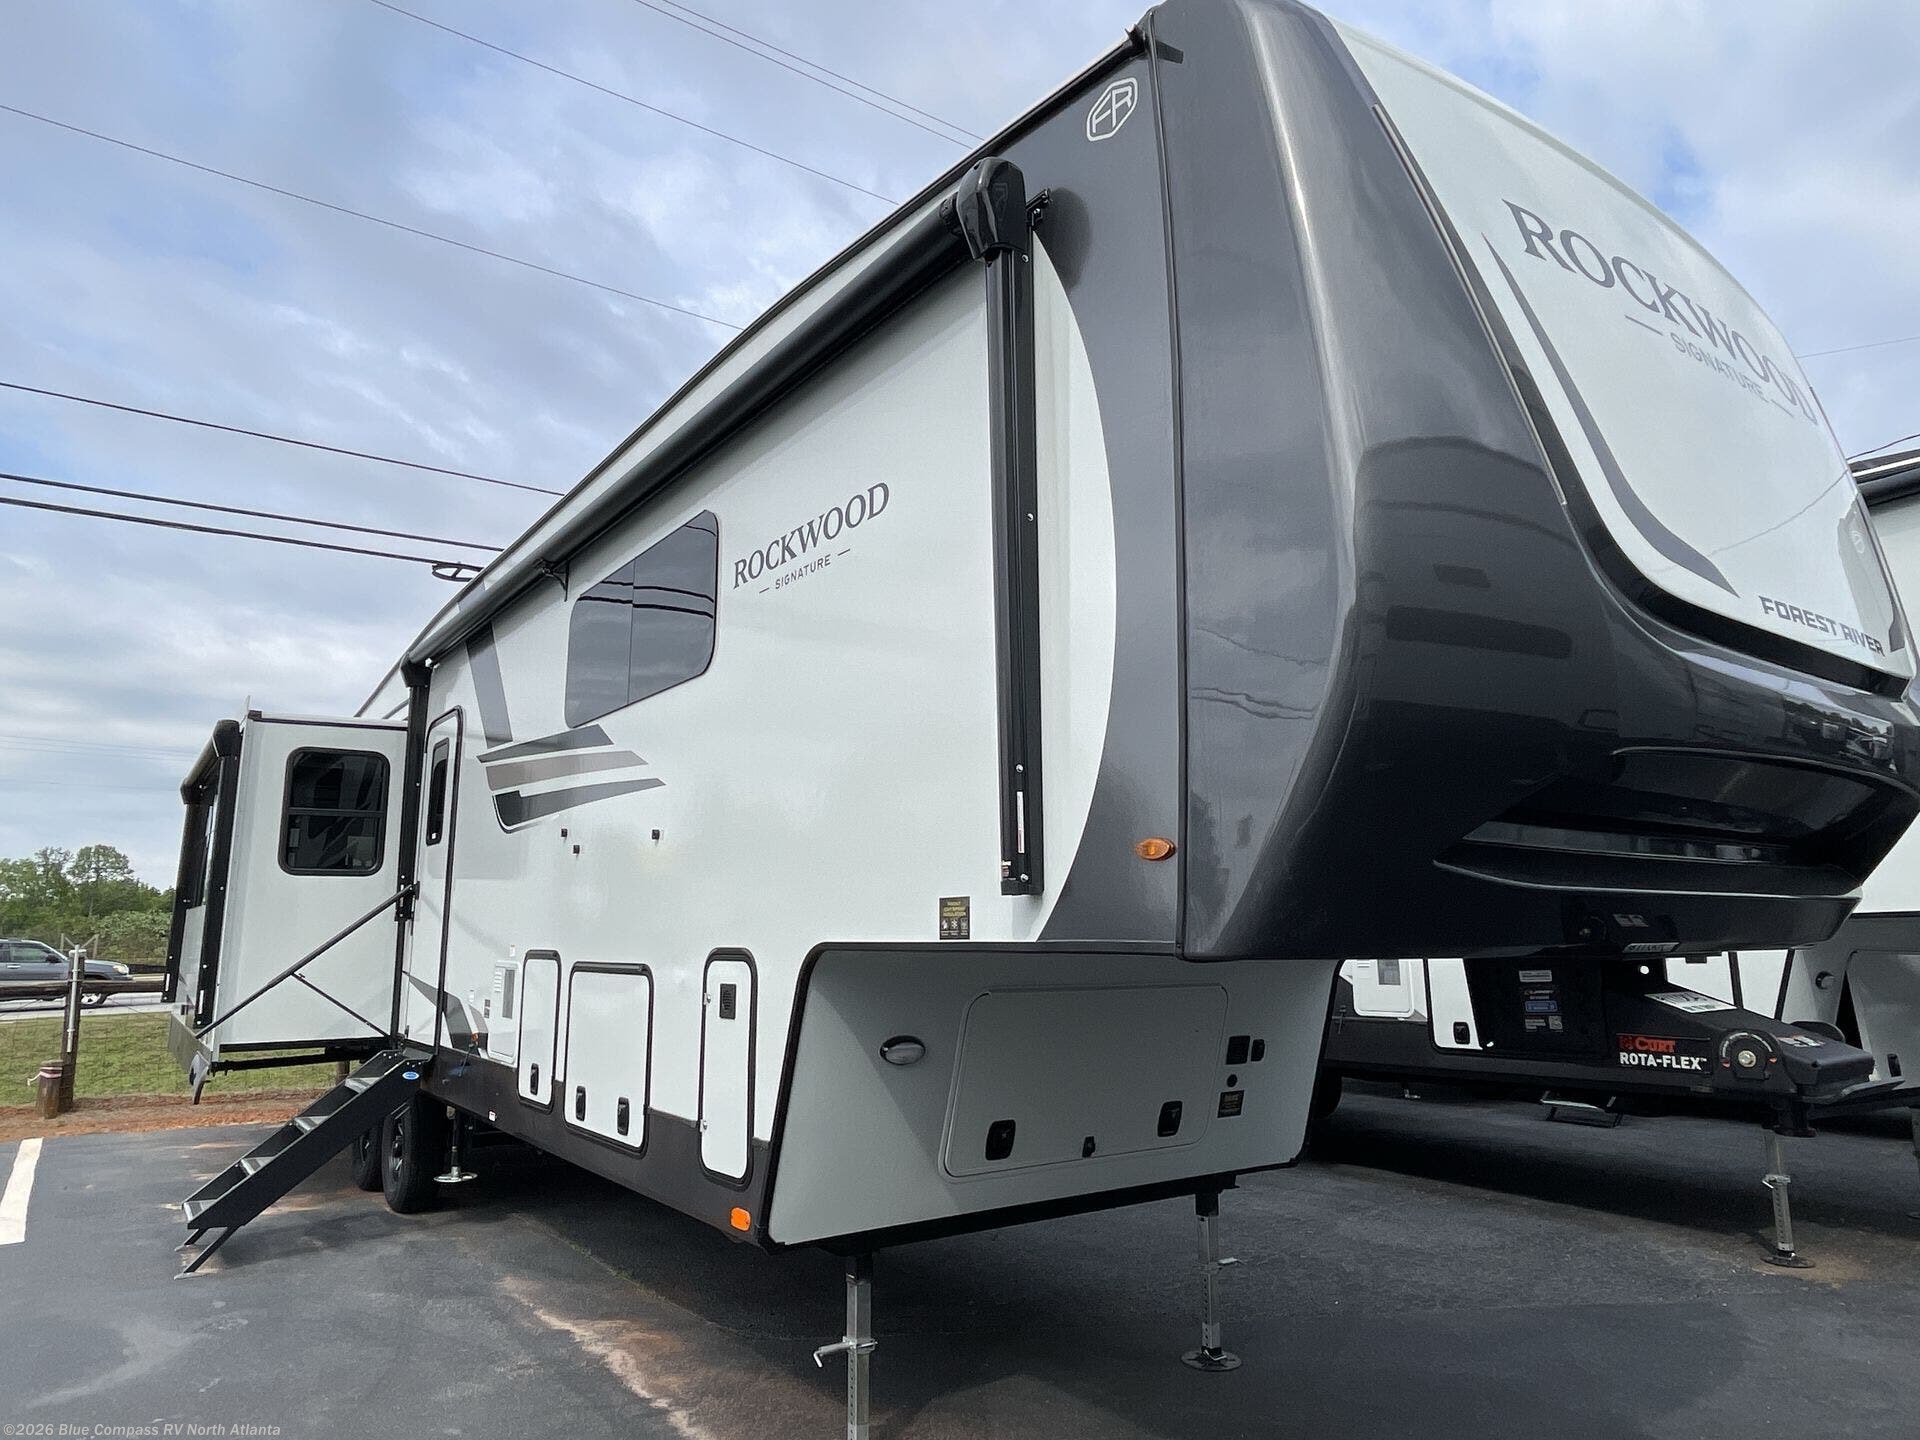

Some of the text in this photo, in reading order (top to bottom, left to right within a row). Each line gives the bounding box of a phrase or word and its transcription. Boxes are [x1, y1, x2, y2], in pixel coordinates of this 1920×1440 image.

[1501, 198, 1819, 426] ROCKWOOD
[1670, 332, 1770, 403] SIGNATURE
[733, 482, 890, 590] ROCKWOOD
[775, 553, 832, 590] SIGNATURE
[1758, 595, 1886, 657] FOREST RIVER
